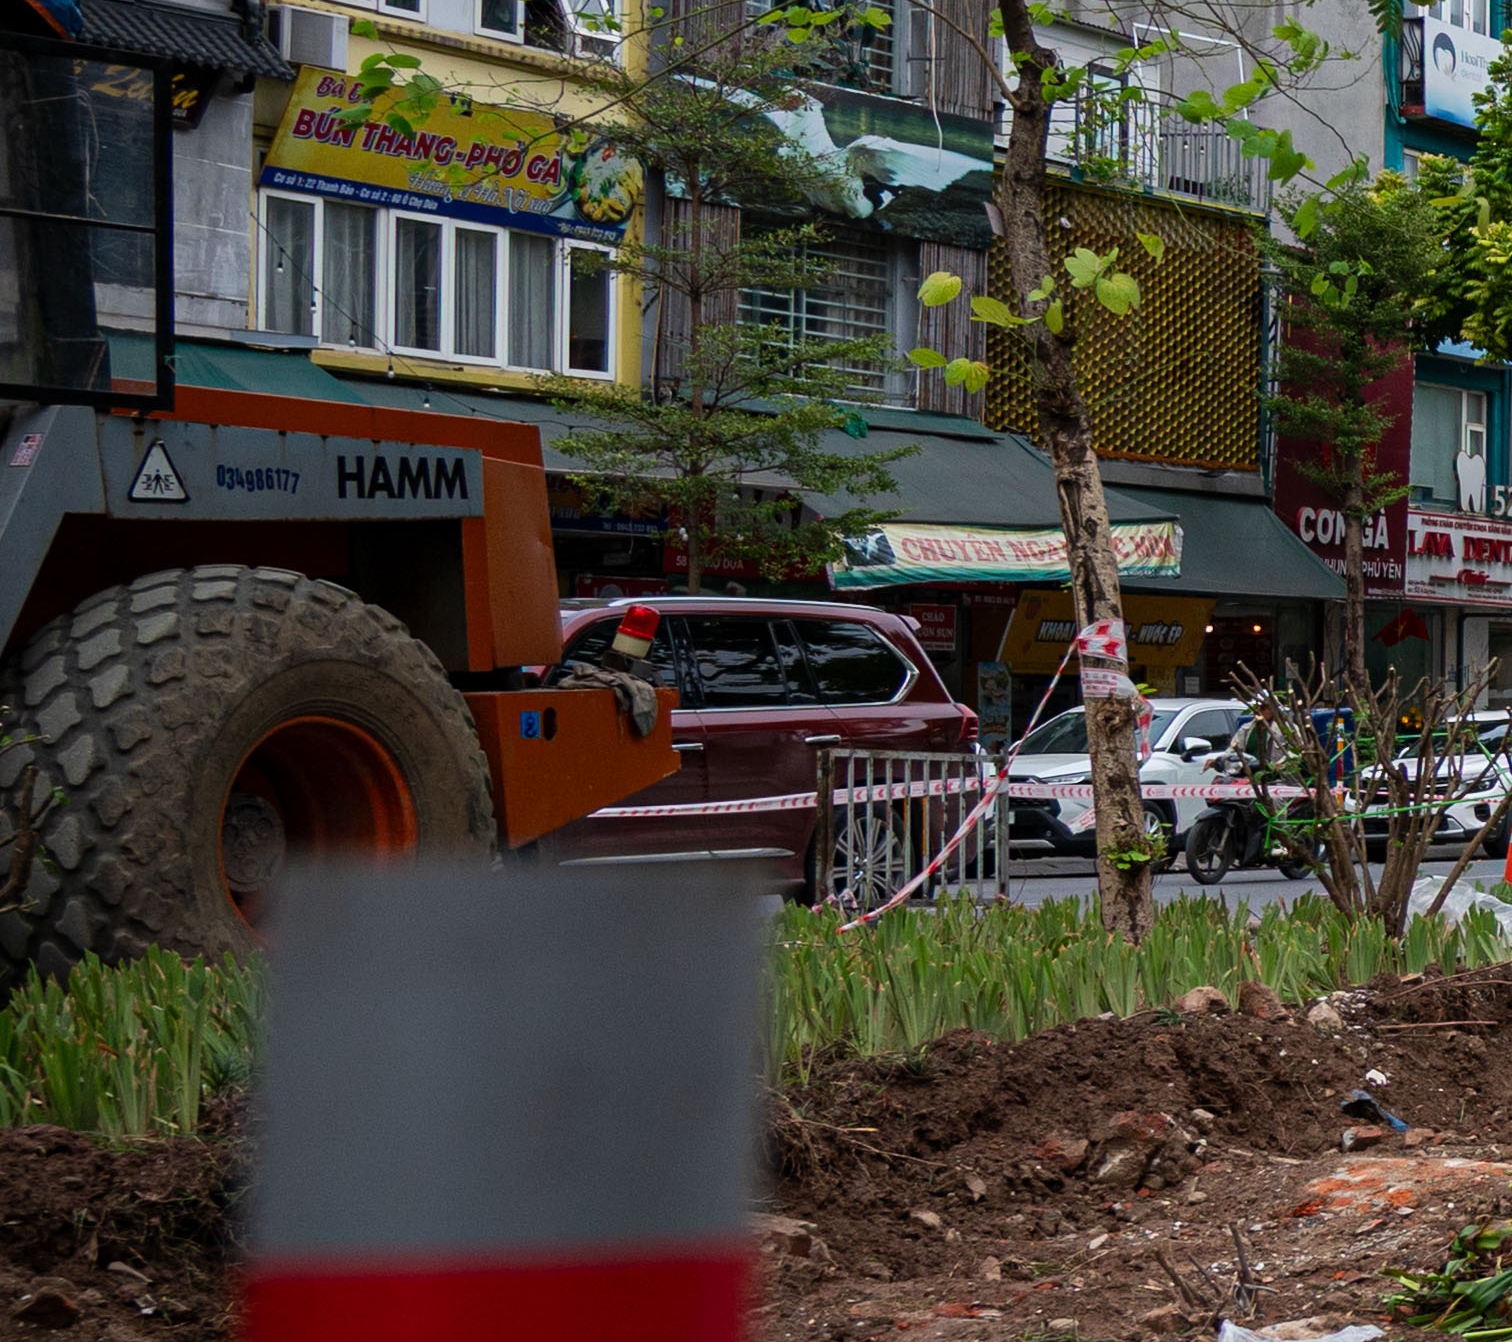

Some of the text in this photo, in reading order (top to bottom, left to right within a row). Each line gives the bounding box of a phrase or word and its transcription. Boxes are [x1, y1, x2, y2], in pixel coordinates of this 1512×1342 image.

[316, 75, 345, 99] Bà
[526, 149, 564, 185] GÀ
[338, 455, 468, 500] HAMM
[1361, 507, 1390, 550] GÀ
[902, 534, 1003, 562] CHUYÊN
[1408, 530, 1456, 558] LAVA
[675, 555, 688, 568] 58
